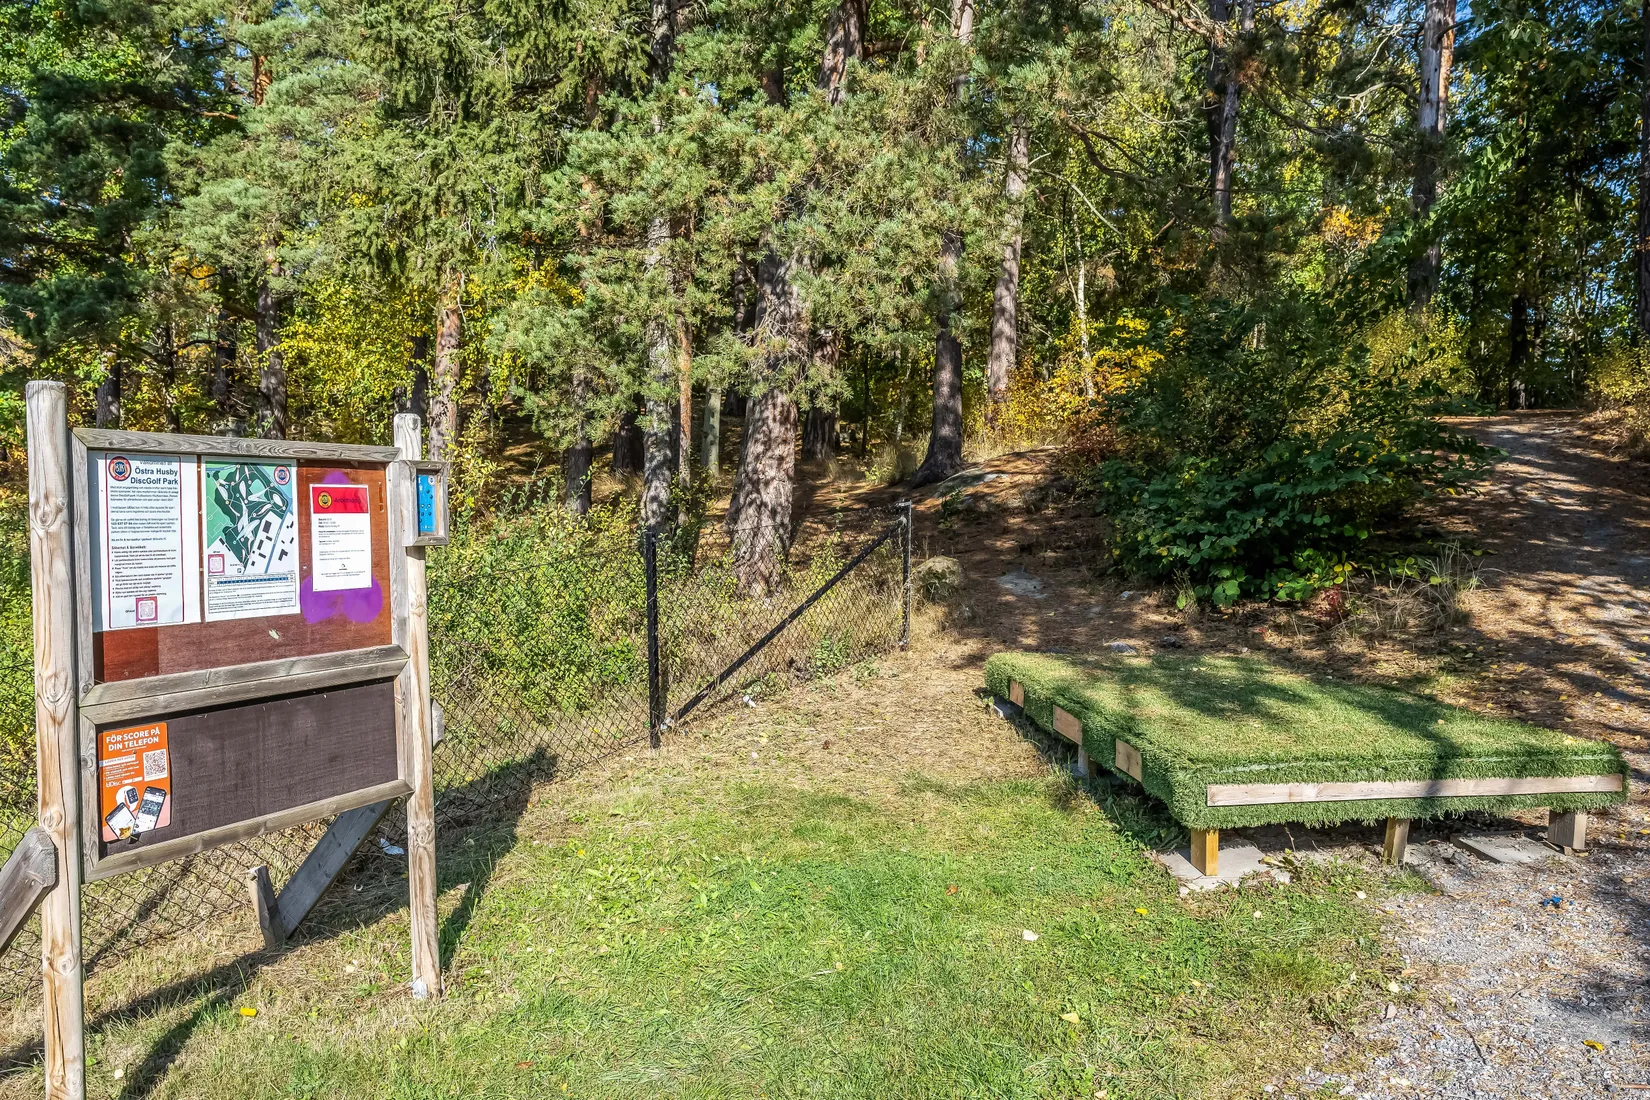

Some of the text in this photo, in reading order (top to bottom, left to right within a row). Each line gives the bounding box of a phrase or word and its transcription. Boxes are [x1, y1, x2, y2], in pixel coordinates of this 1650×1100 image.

[134, 465, 178, 477] Östra Husby
[130, 477, 179, 485] DiscGolf Park
[106, 726, 160, 743] FÖR SCORE PÅ
[108, 743, 122, 751] DIN
[124, 736, 159, 748] TELEFON
